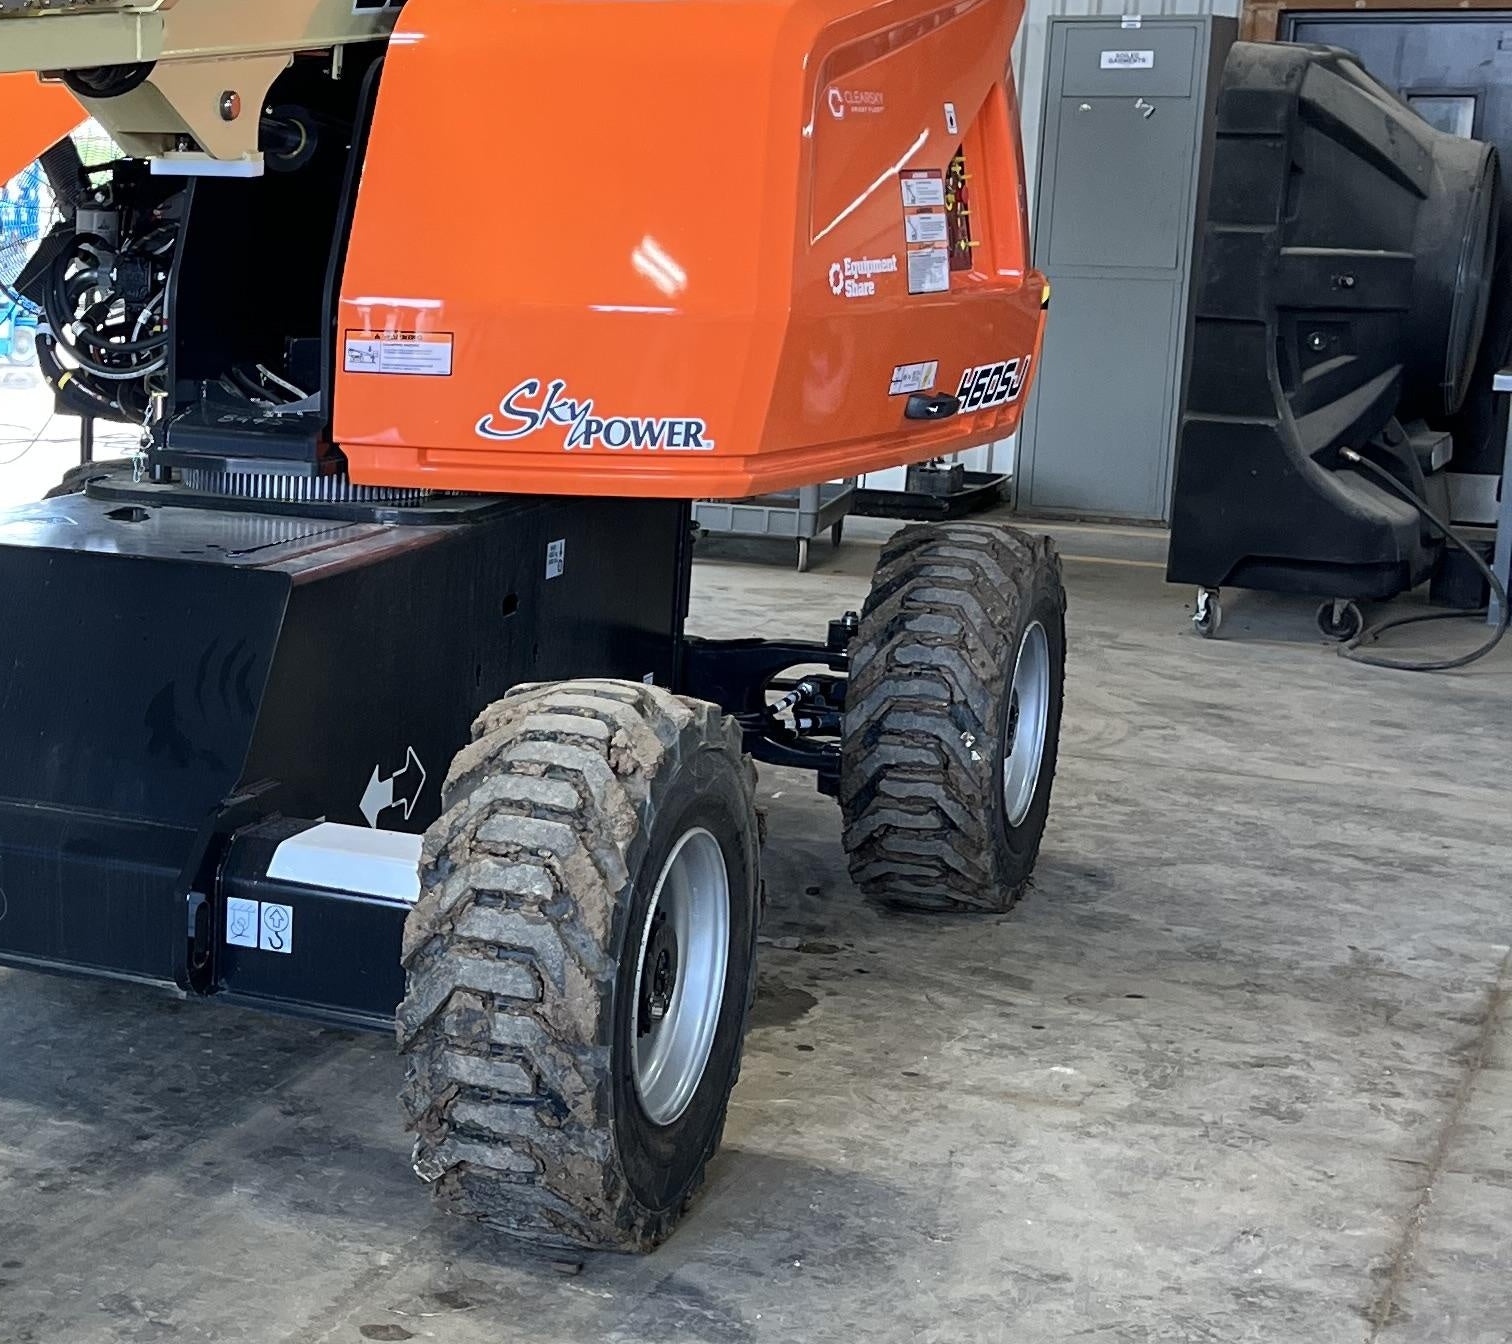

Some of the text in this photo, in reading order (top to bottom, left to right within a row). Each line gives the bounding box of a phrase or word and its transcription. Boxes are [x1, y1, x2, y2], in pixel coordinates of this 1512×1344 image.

[843, 255, 898, 279] Equipment
[844, 280, 875, 297] Share
[955, 355, 1031, 414] 460SJ
[478, 380, 592, 448] Sky
